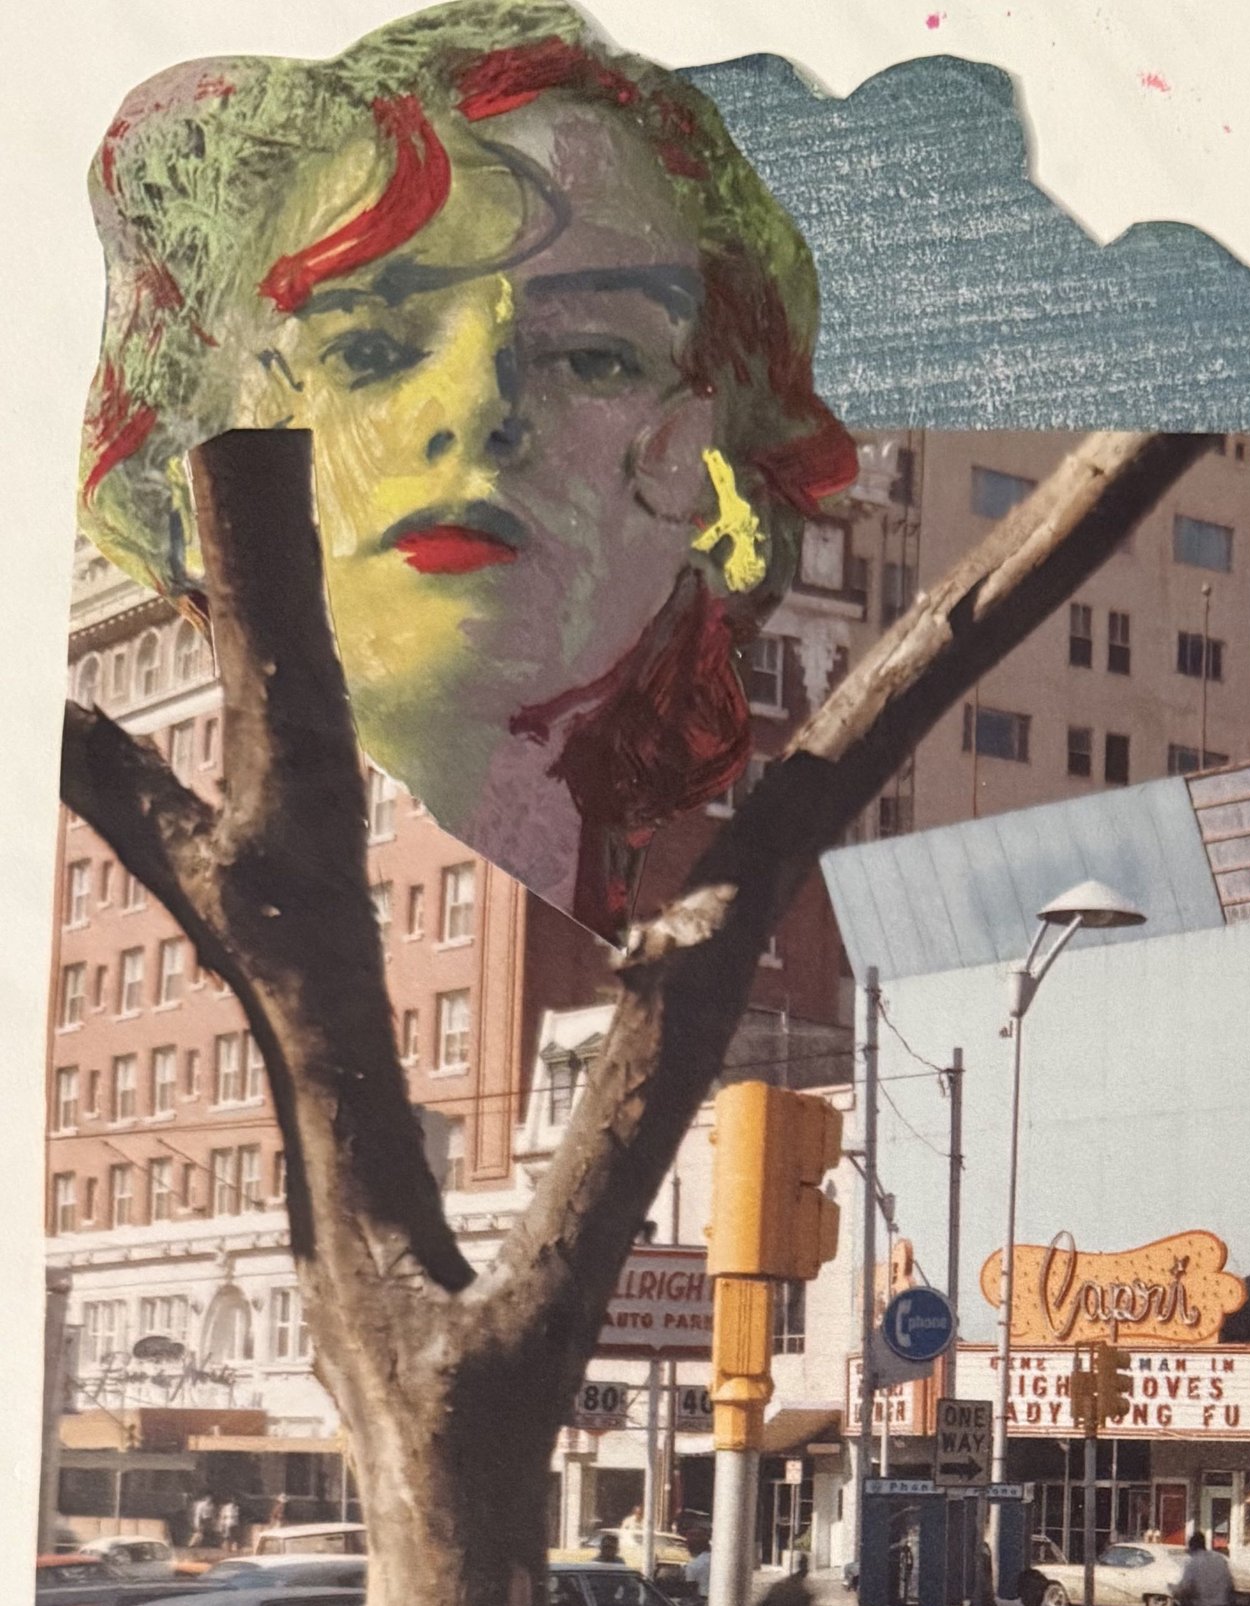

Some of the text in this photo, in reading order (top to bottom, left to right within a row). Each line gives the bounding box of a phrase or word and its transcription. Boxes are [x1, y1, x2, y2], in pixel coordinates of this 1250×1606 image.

[1038, 1230, 1201, 1342] Capri
[907, 1316, 947, 1332] phone
[1008, 1374, 1071, 1398] IGH
[583, 1385, 619, 1412] 80
[944, 1406, 985, 1428] ONE
[1007, 1402, 1062, 1423] ADY
[1203, 1404, 1241, 1427] FU
[940, 1433, 985, 1453] WAY
[889, 1481, 929, 1491] Phon
